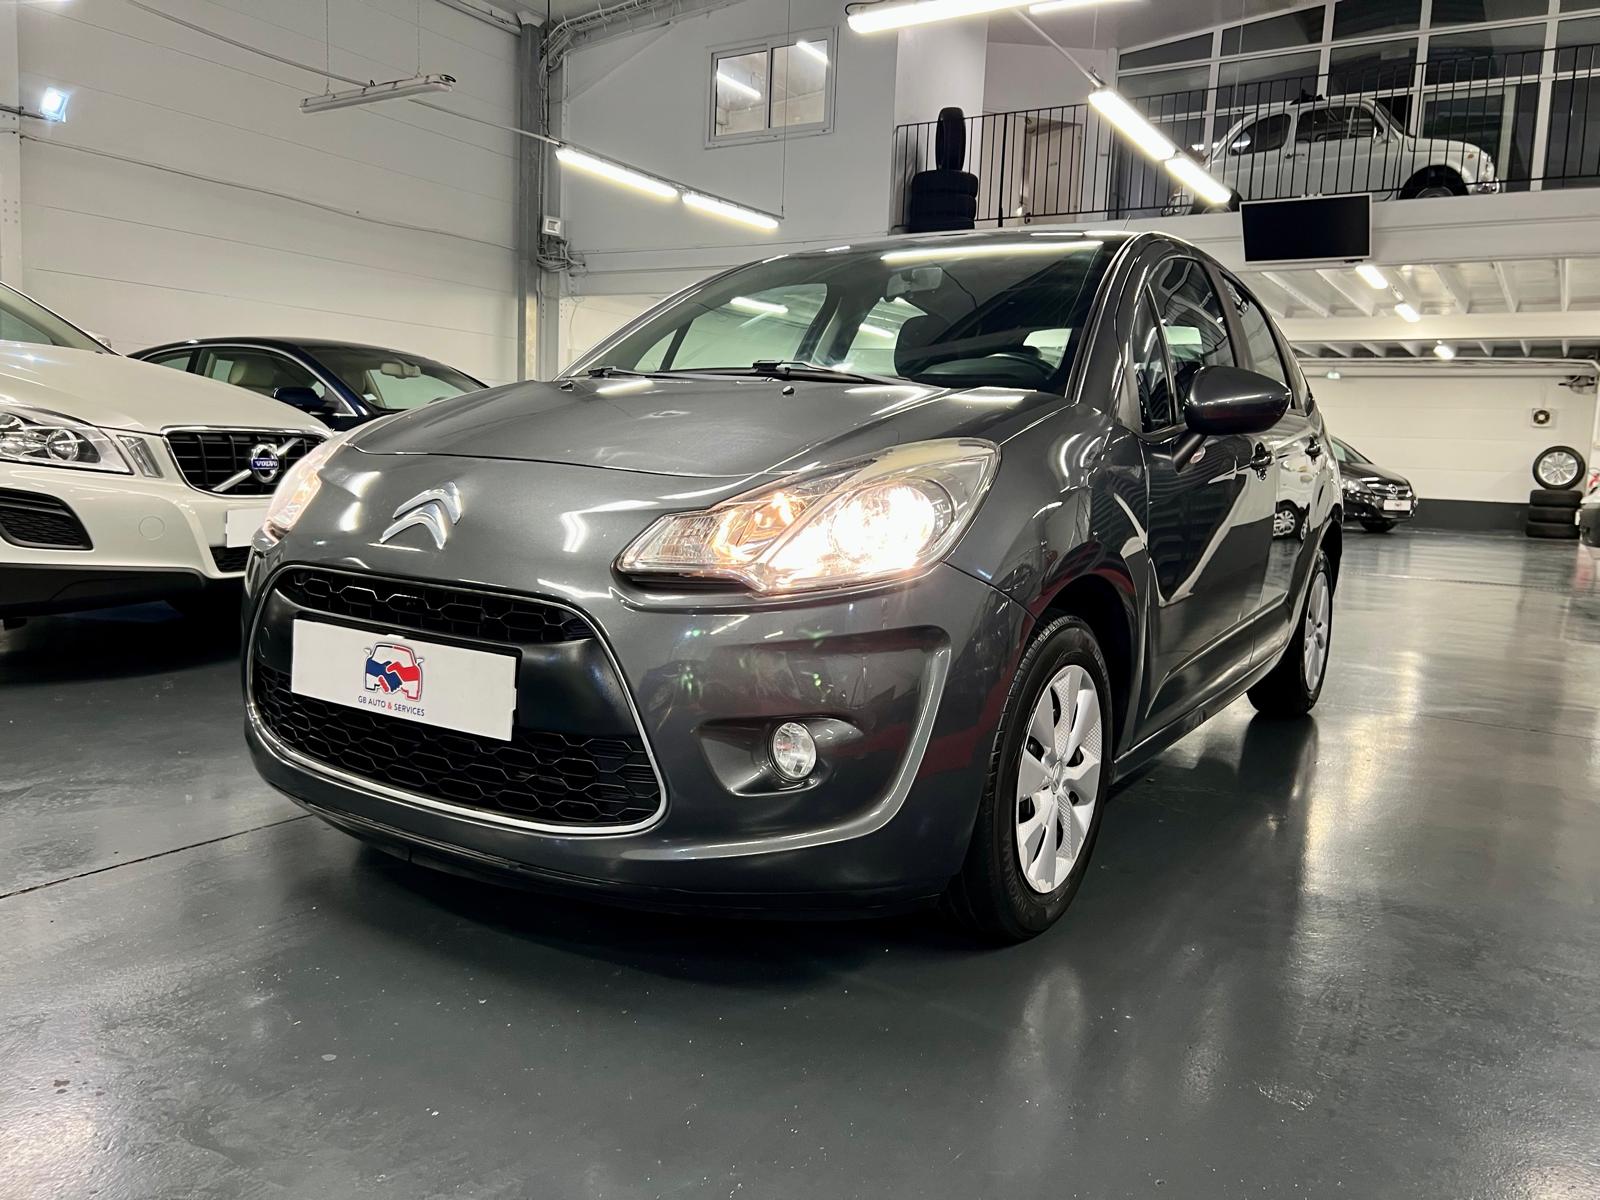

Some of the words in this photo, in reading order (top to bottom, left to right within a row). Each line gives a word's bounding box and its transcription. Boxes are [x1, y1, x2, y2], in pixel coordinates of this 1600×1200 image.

[368, 698, 386, 708] AUTO
[387, 702, 392, 710] &
[394, 703, 425, 716] SERVICES
